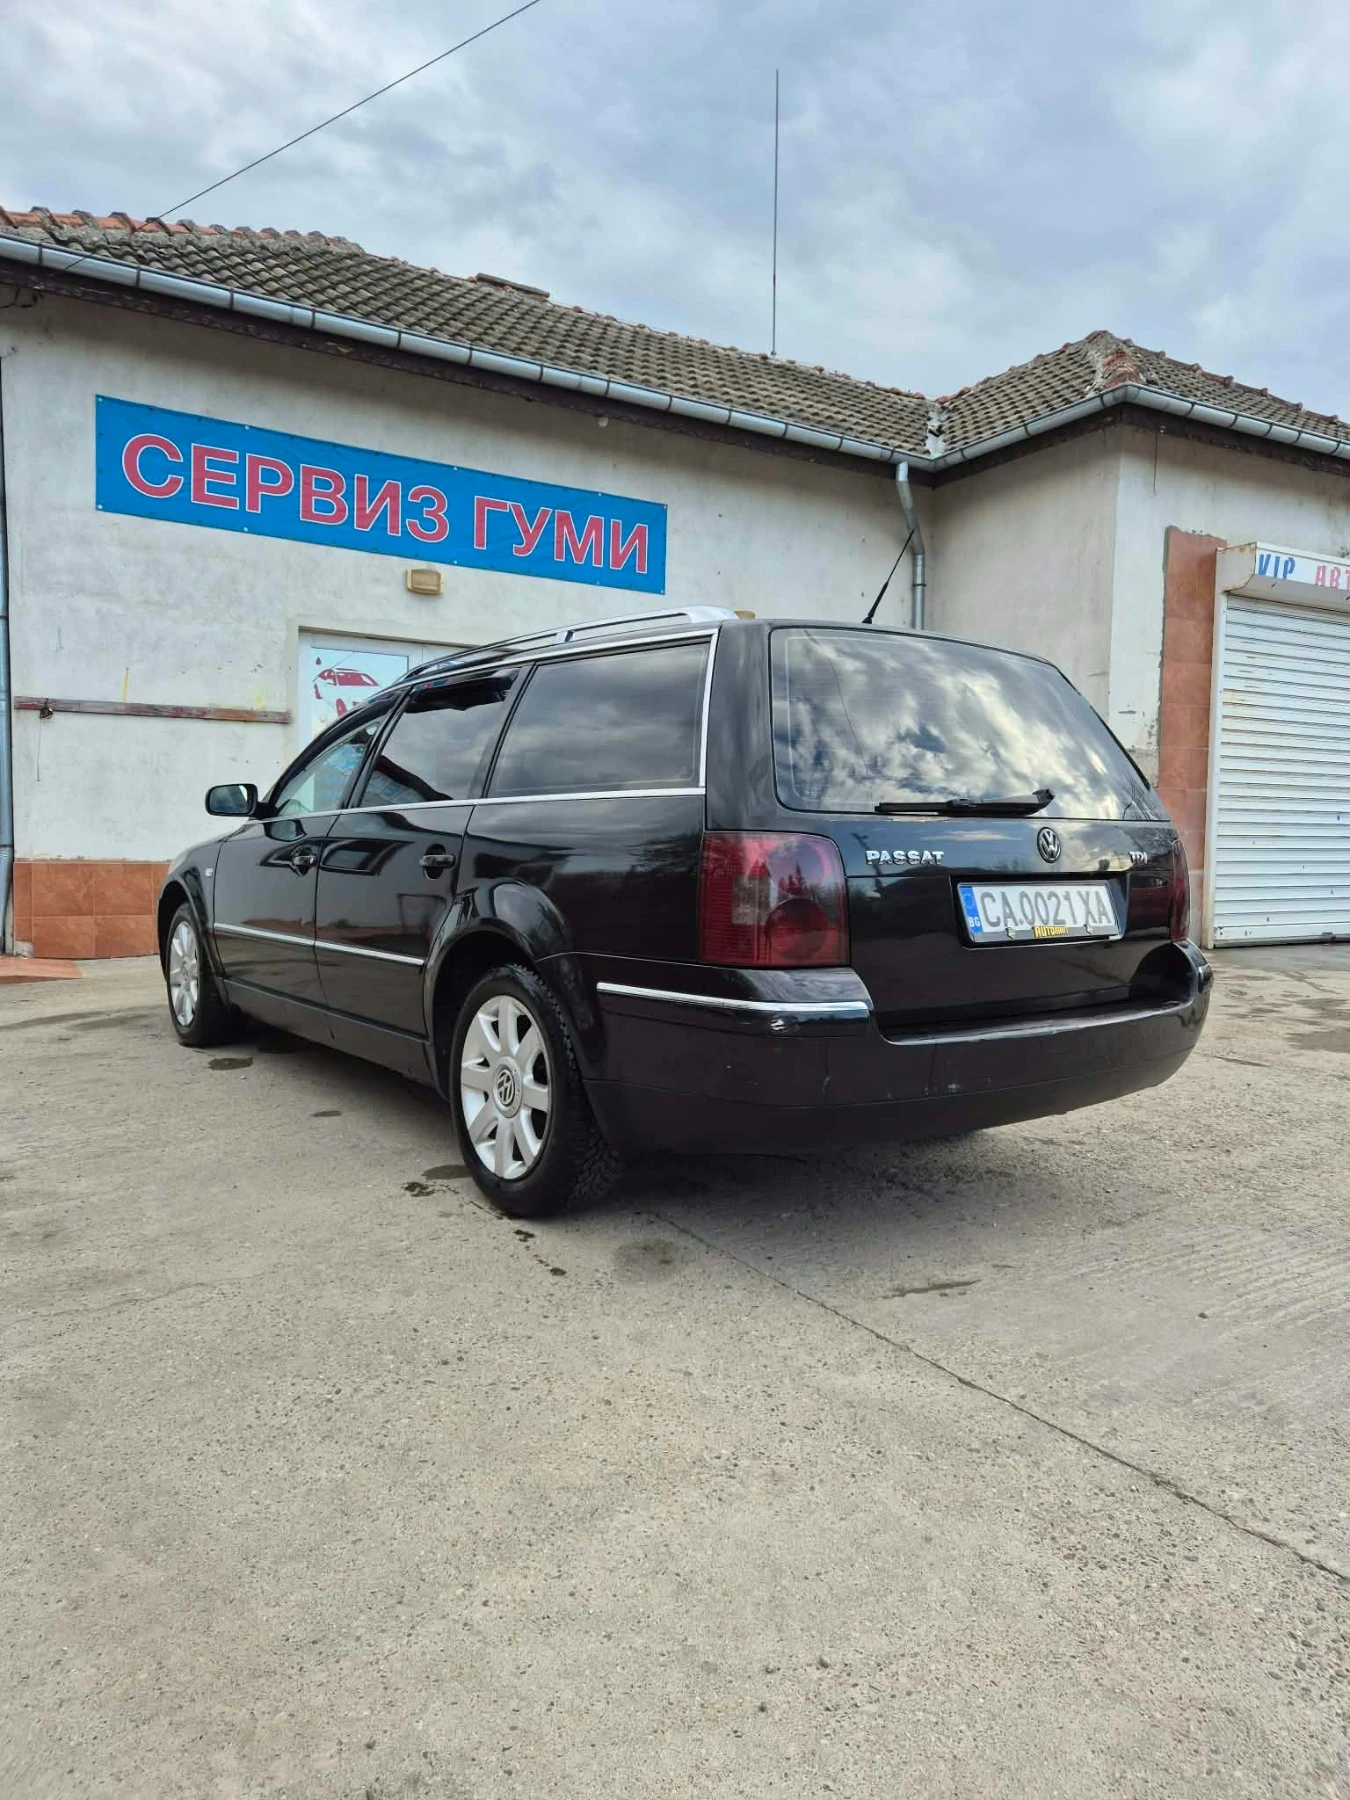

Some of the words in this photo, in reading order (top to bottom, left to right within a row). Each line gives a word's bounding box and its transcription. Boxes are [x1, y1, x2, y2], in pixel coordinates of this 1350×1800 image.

[122, 432, 450, 543] СЕРВИЗ
[473, 495, 649, 574] ГУМИ
[1257, 553, 1295, 579] VIP
[865, 850, 945, 865] PASSAT
[969, 916, 981, 928] BG
